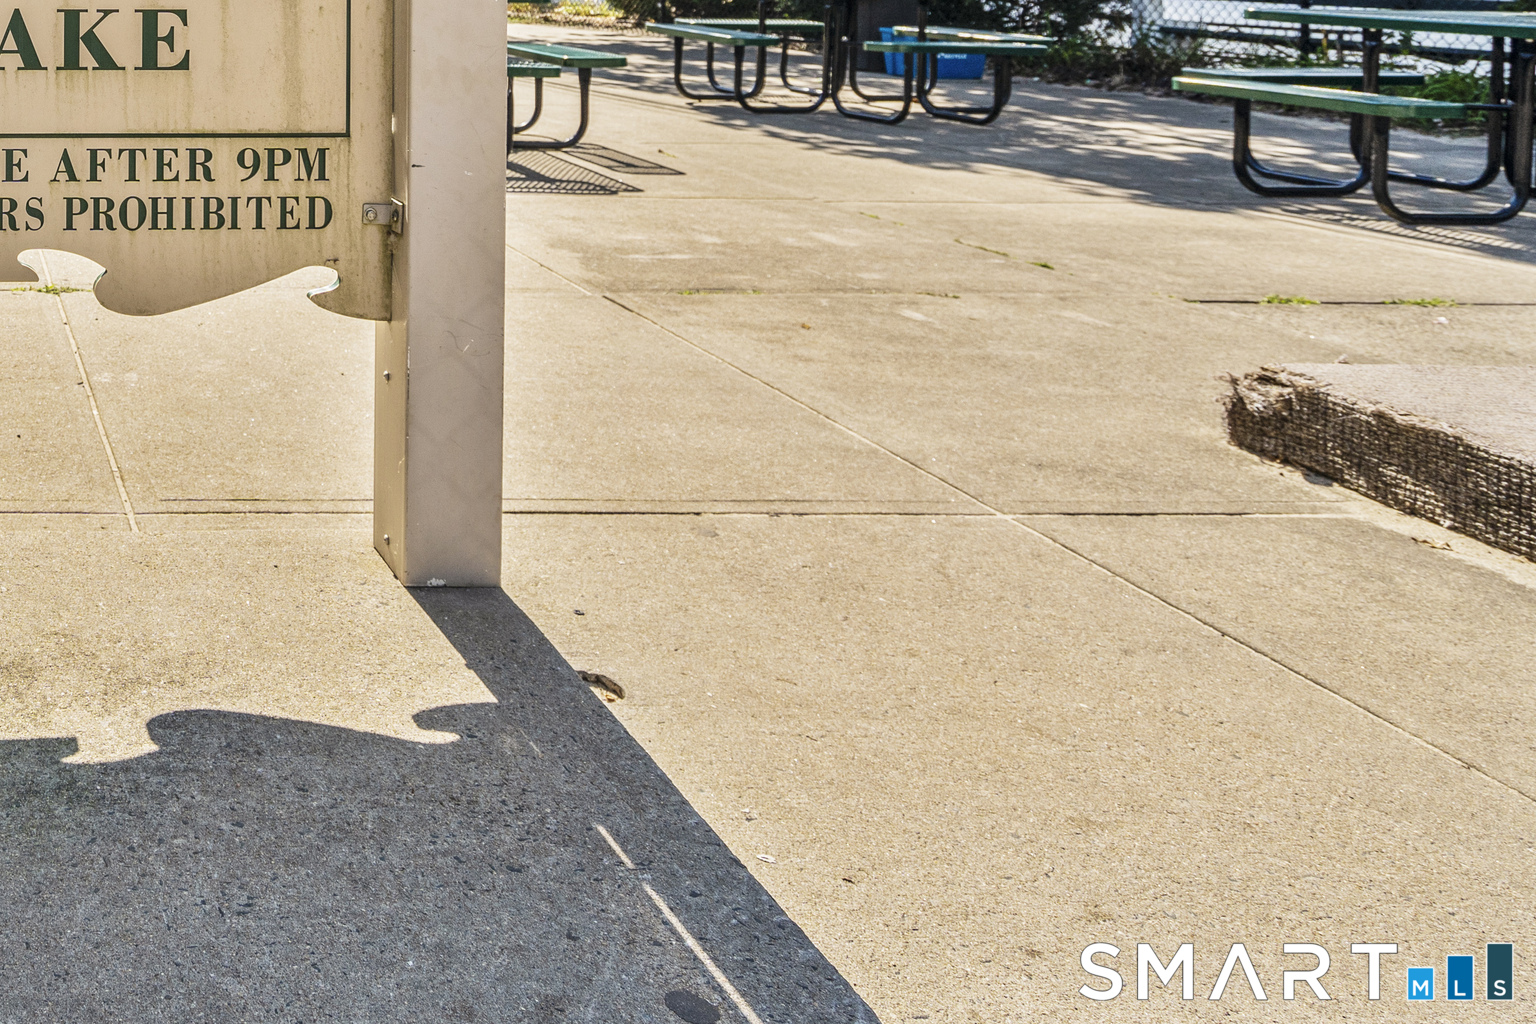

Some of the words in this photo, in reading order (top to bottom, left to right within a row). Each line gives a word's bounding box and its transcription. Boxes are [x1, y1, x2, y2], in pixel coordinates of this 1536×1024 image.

[52, 147, 215, 183] AFTER
[236, 147, 330, 182] 9PM
[63, 195, 332, 231] PROHIBITED
